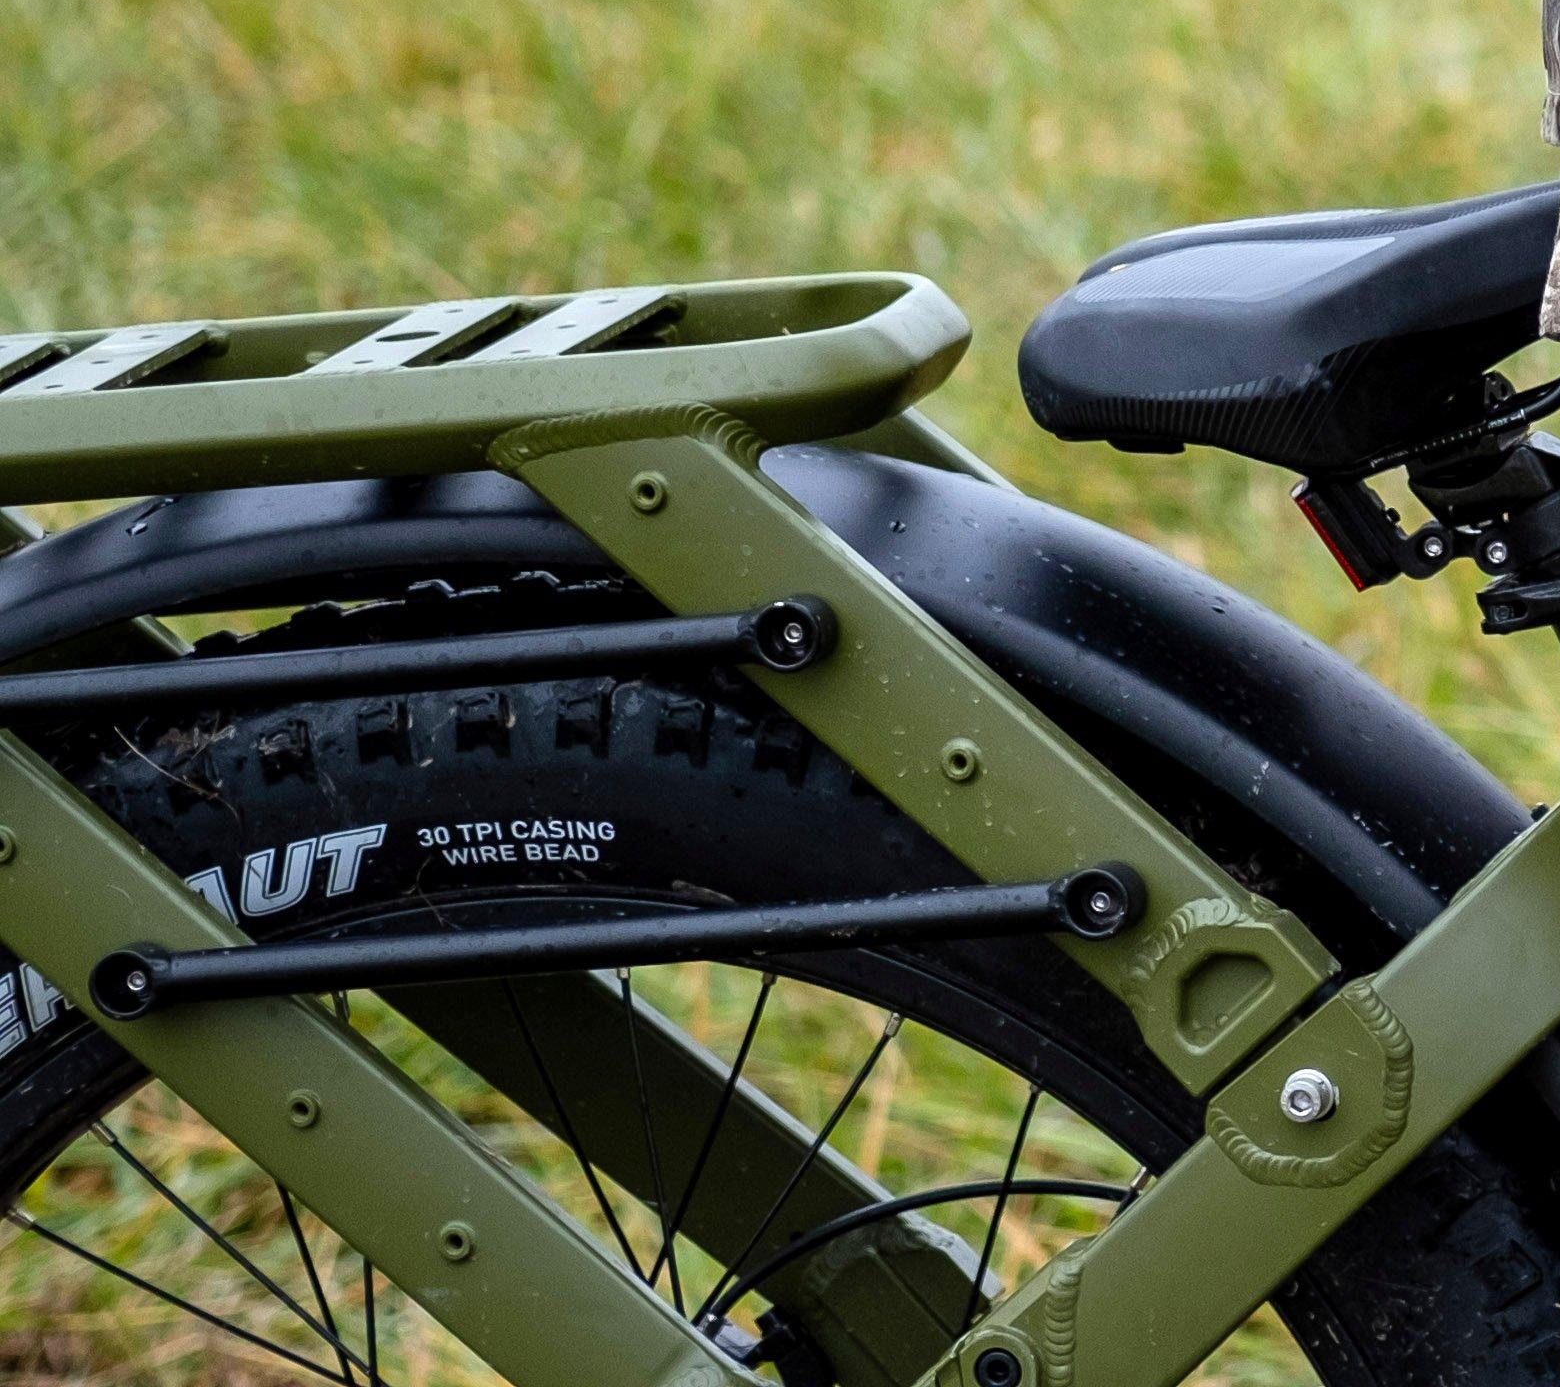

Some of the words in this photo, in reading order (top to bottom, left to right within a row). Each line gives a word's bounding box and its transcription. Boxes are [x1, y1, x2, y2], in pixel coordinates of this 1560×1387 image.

[417, 826, 450, 847] 30
[455, 821, 503, 843] TPI
[510, 820, 616, 841] CASING
[442, 844, 518, 867] WIRE
[524, 843, 600, 862] BEAD
